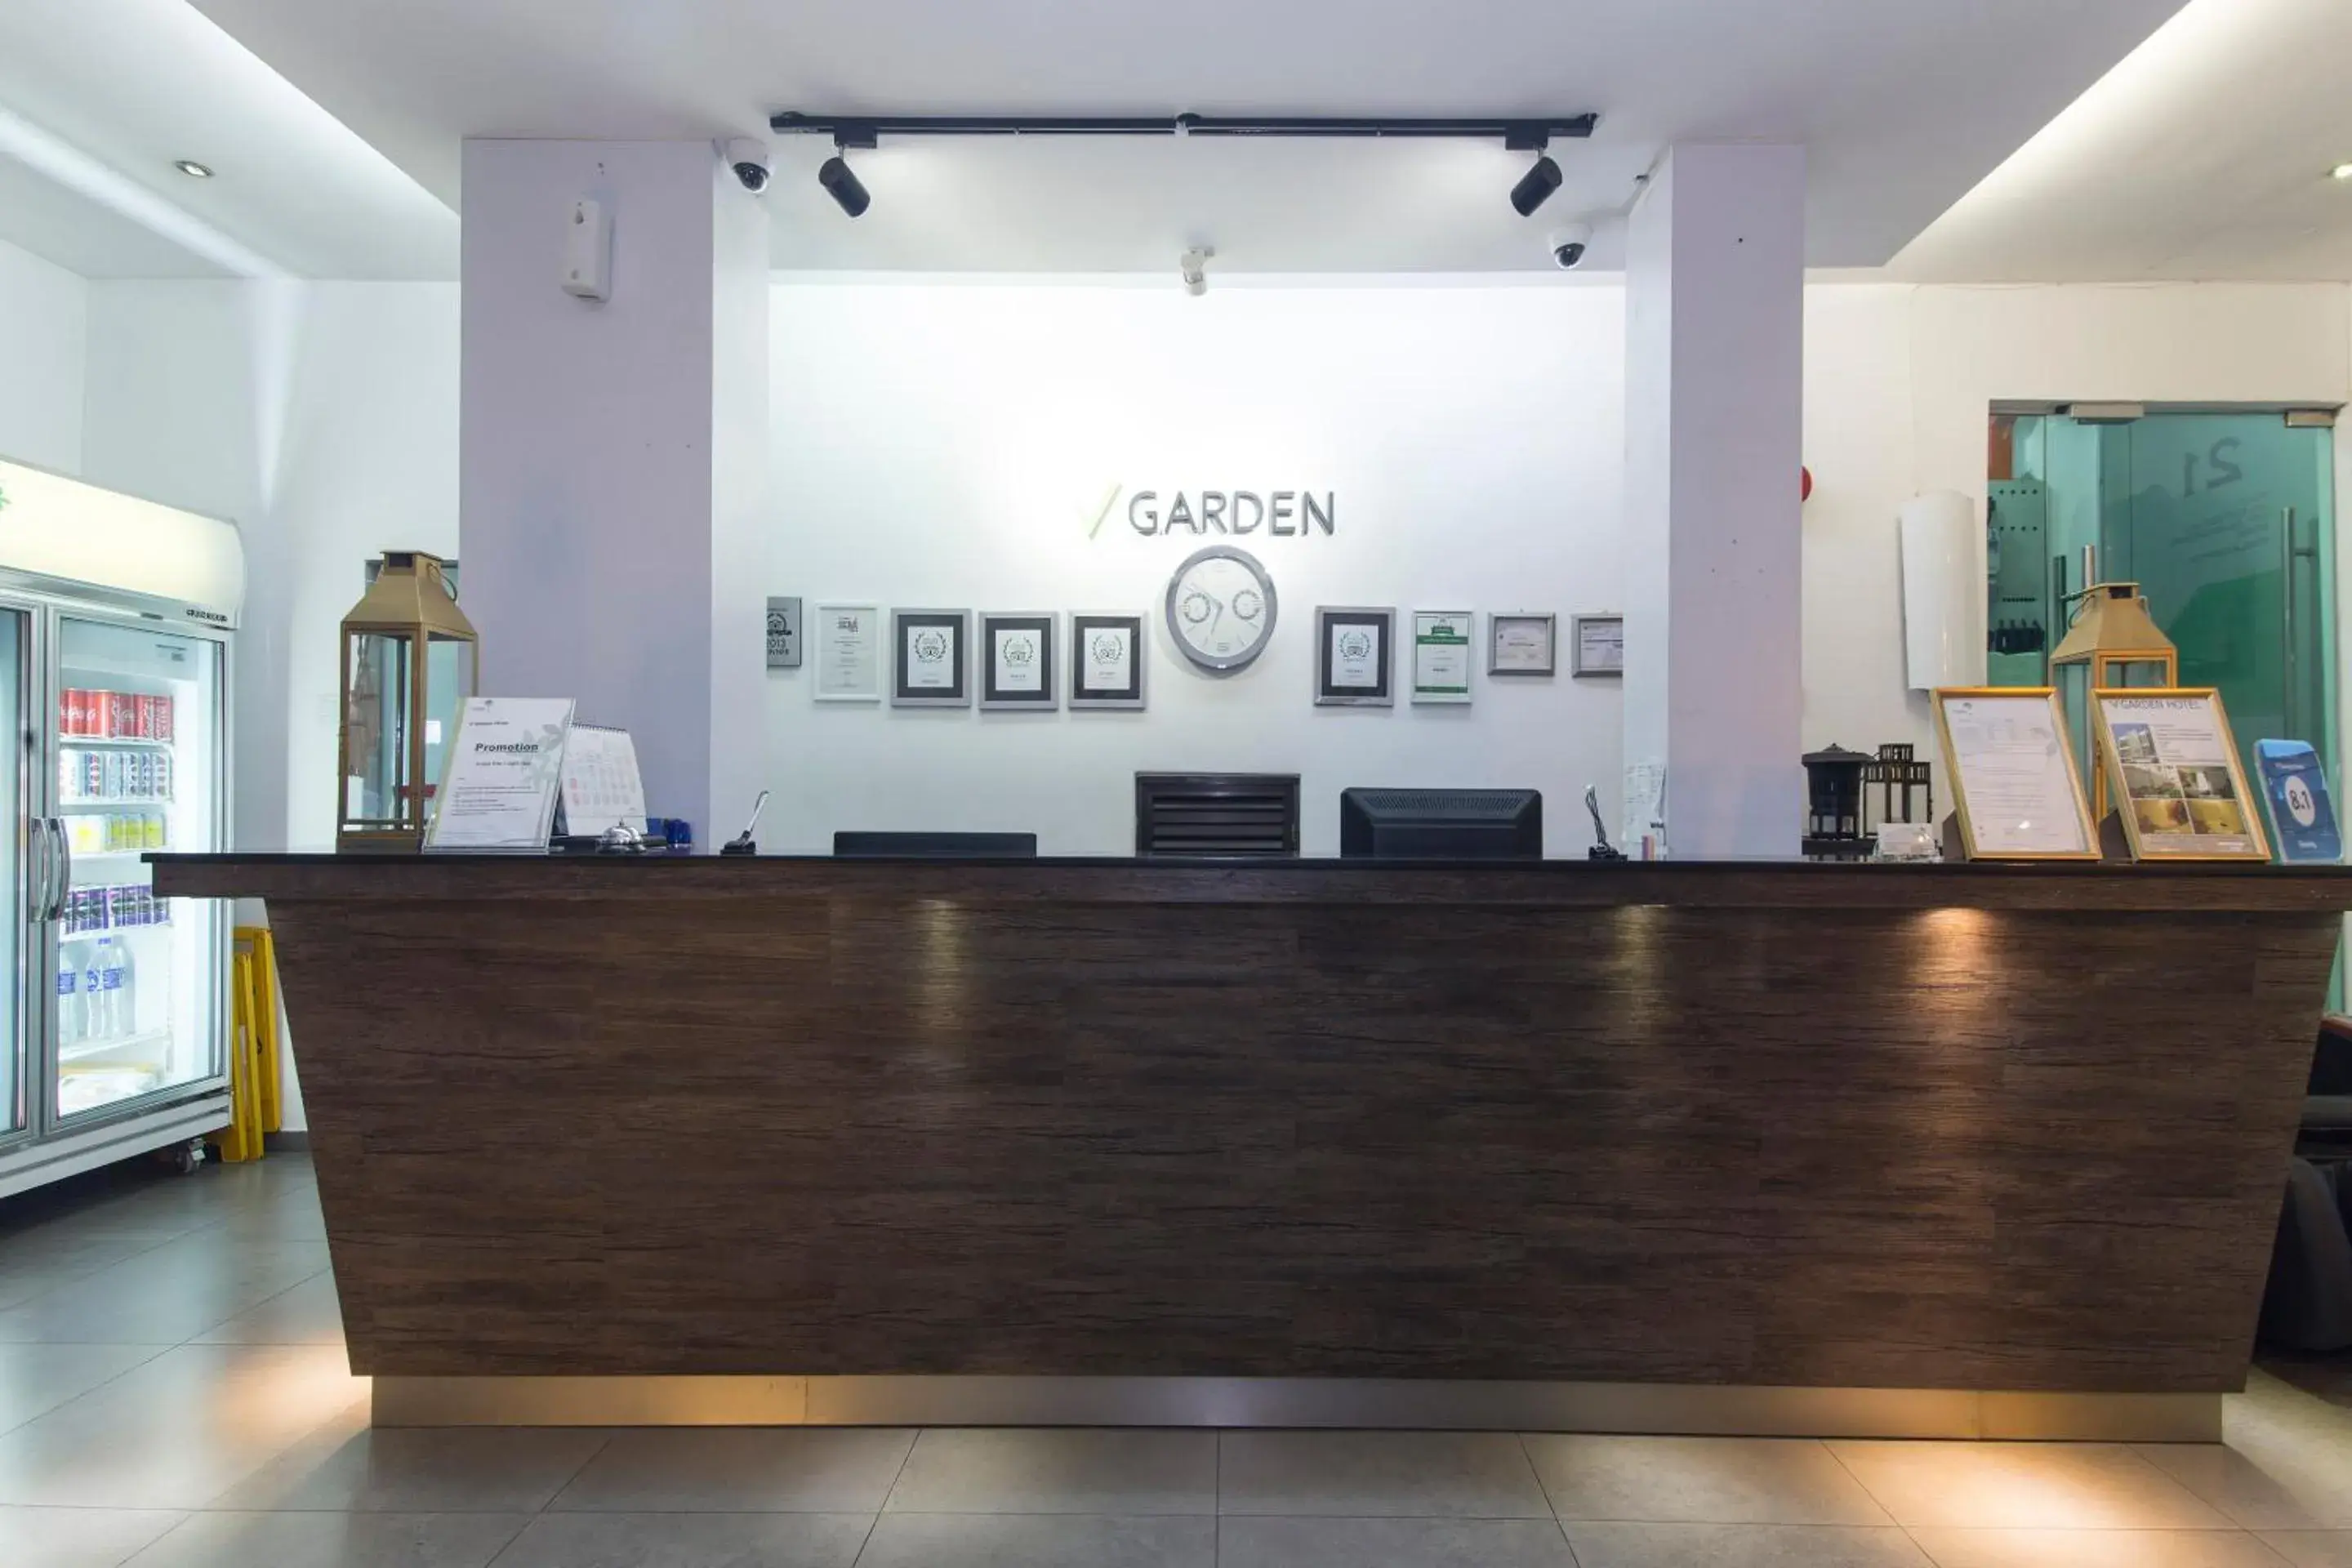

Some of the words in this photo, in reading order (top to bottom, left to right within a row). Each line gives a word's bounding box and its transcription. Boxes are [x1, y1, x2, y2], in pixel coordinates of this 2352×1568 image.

[1129, 491, 1334, 537] GARDEN
[474, 742, 539, 752] Promotion
[2288, 790, 2310, 810] 8.1
